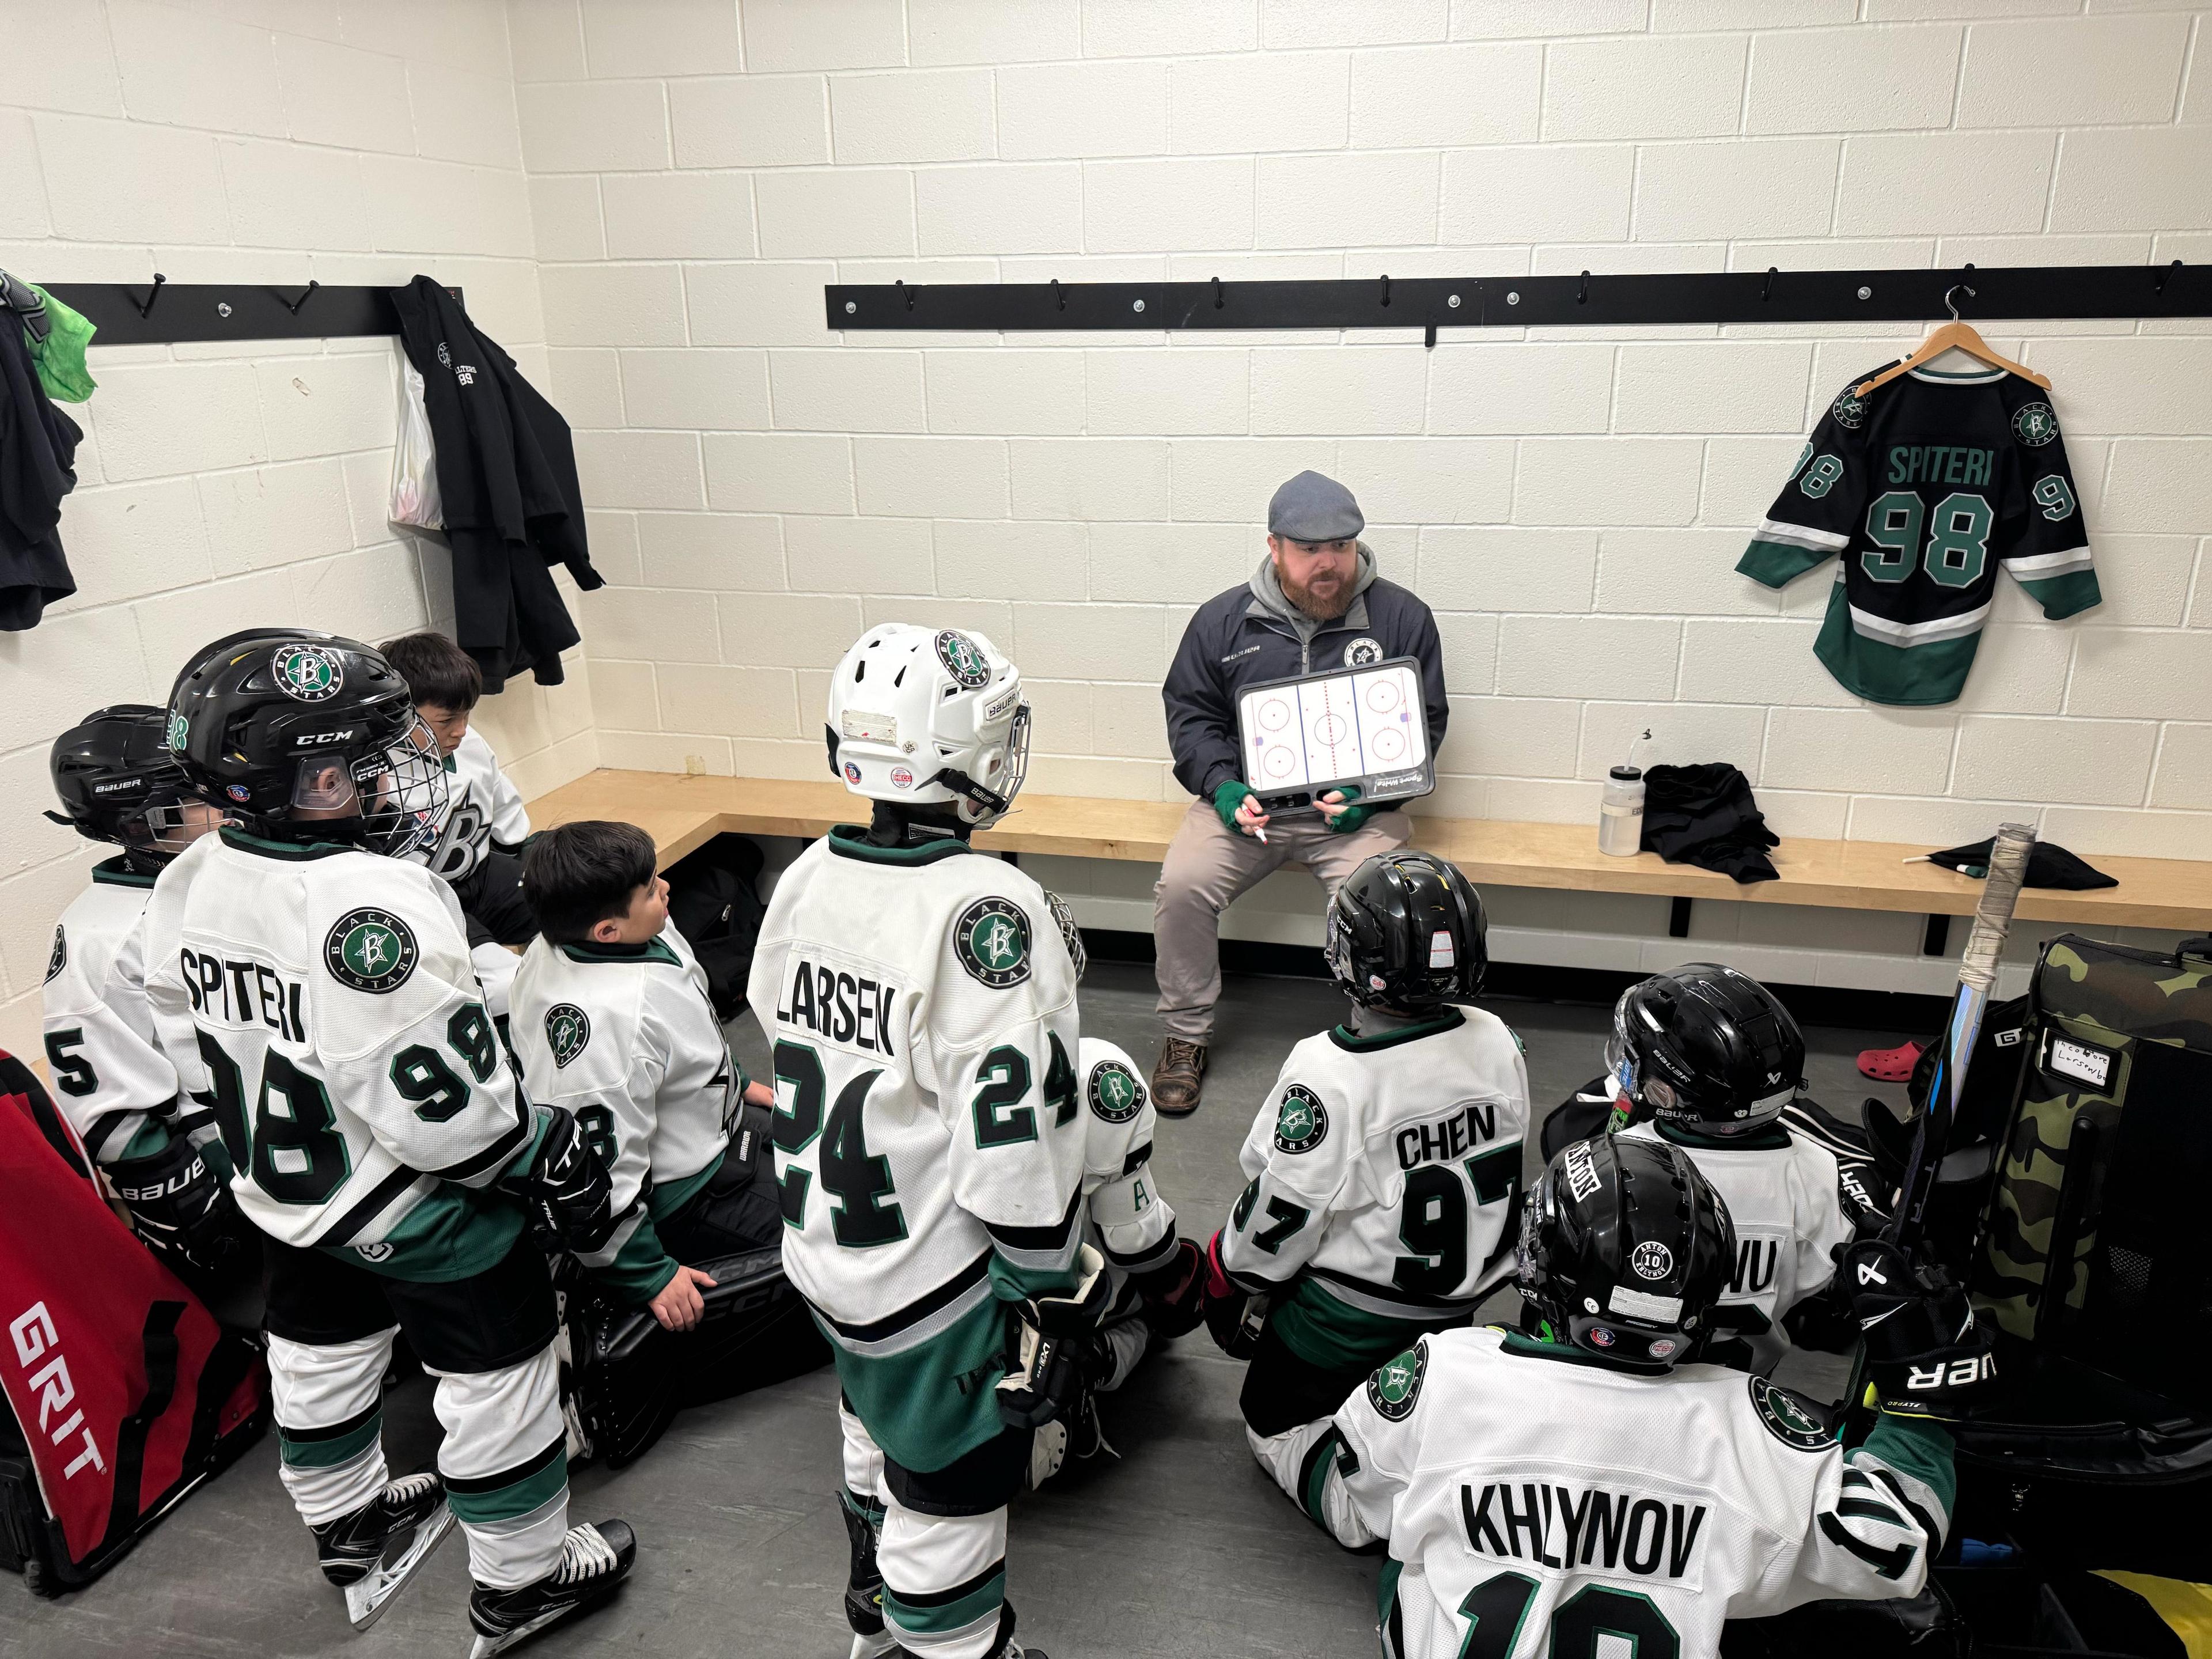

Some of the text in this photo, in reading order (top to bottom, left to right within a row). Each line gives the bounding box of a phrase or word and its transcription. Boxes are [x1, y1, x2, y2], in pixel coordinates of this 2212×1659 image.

[454, 365, 477, 374] LTERS
[458, 373, 474, 385] 89
[2014, 404, 2046, 429] BLACK
[1888, 446, 1995, 486] SPITERI
[1860, 491, 1995, 589] 98
[277, 646, 328, 668] BLACK
[1350, 641, 1378, 652] BLACK
[290, 676, 340, 699] STARS
[990, 693, 1016, 717] BAUER
[297, 730, 354, 745] CCM
[94, 779, 142, 793] BAUER
[357, 765, 389, 782] CCM
[971, 787, 994, 804] BAUER
[331, 913, 393, 955] BLACK
[960, 903, 1021, 941] BLACK
[1336, 914, 1353, 935] CCM
[354, 946, 412, 988] STARS
[180, 948, 306, 1043] SPITERI
[777, 960, 895, 1057] LARSEN
[44, 1027, 99, 1097] 5
[389, 1002, 497, 1123] 98
[1653, 1049, 1691, 1084] BAUER
[975, 1029, 1079, 1150] 24
[1092, 1063, 1120, 1100] BLACK
[1109, 1081, 1143, 1119] STARS
[1286, 1087, 1323, 1124] BLACK
[1656, 1108, 1698, 1122] BAUR
[739, 1130, 751, 1162] WARRIOR
[771, 1037, 910, 1248] 24
[1396, 1105, 1495, 1171] CHEN
[122, 1153, 205, 1201] BAUE
[1133, 1177, 1150, 1212] A
[1392, 1139, 1524, 1298] 97
[1641, 1243, 1667, 1256] ANTON
[1643, 1253, 1661, 1268] 10
[1635, 1262, 1666, 1277] KHLYNOV
[1586, 1301, 1596, 1310] CE
[9, 1300, 104, 1481] GRIT
[1370, 1381, 1393, 1414] ARS
[387, 1512, 417, 1533] CCM
[1461, 1483, 1707, 1579] KHLYNOV
